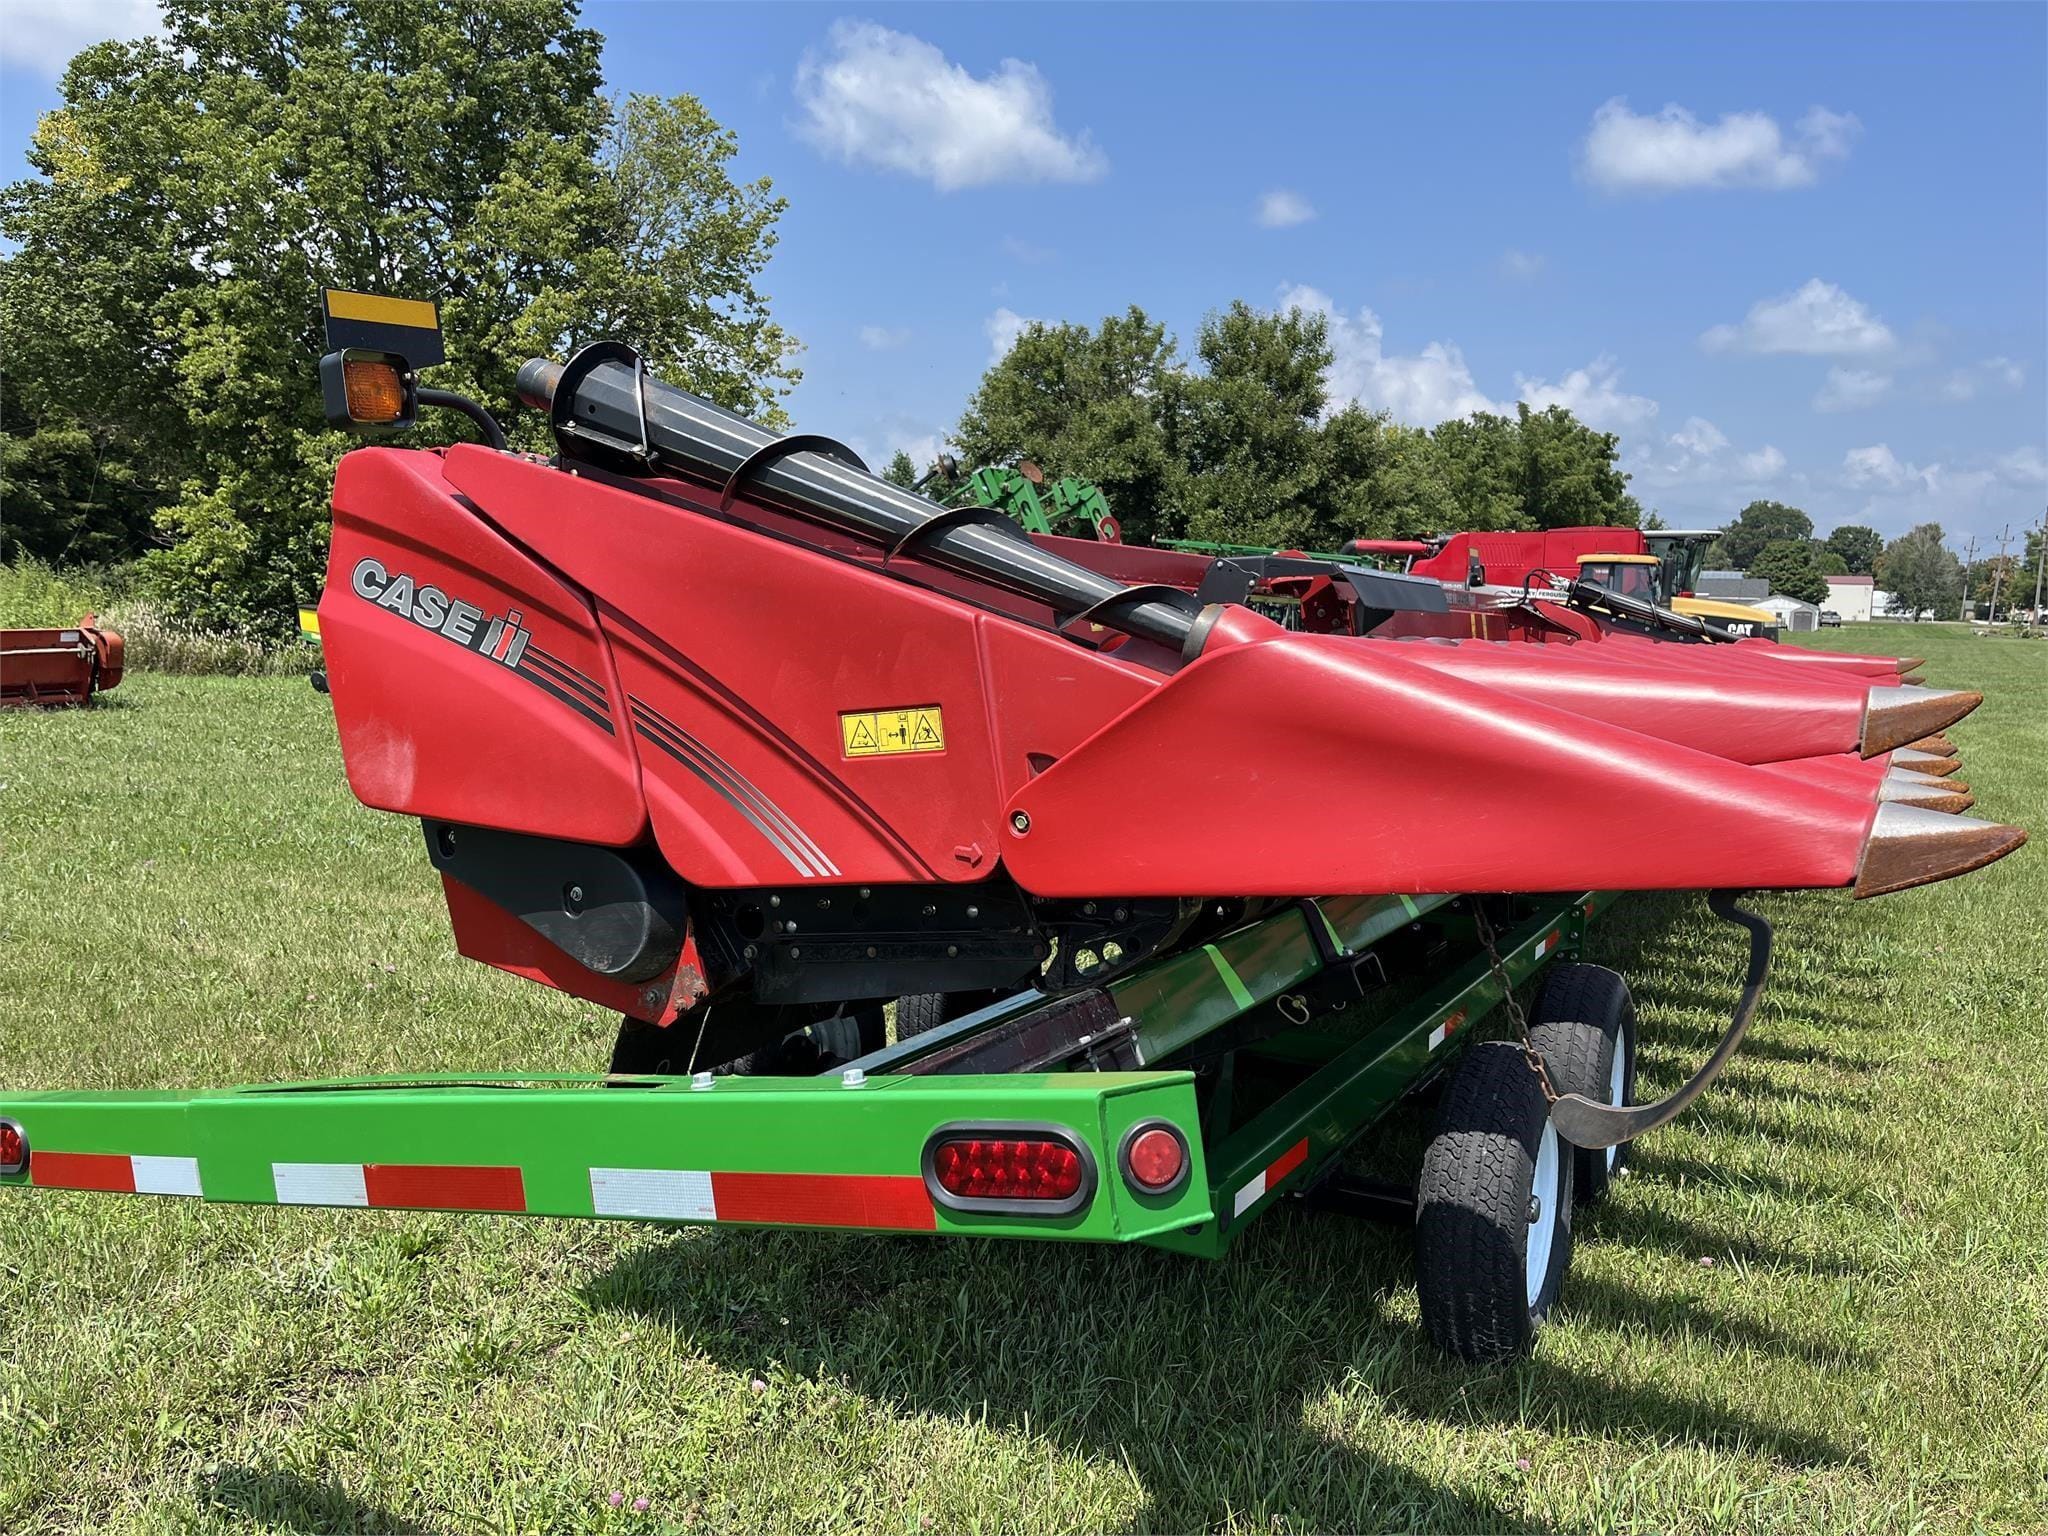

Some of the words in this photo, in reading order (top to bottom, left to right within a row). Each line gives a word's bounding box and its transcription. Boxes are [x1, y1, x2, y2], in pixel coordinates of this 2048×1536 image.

[1510, 588, 1536, 597] MASEY
[352, 558, 484, 646] CASE
[1727, 623, 1754, 637] CAT
